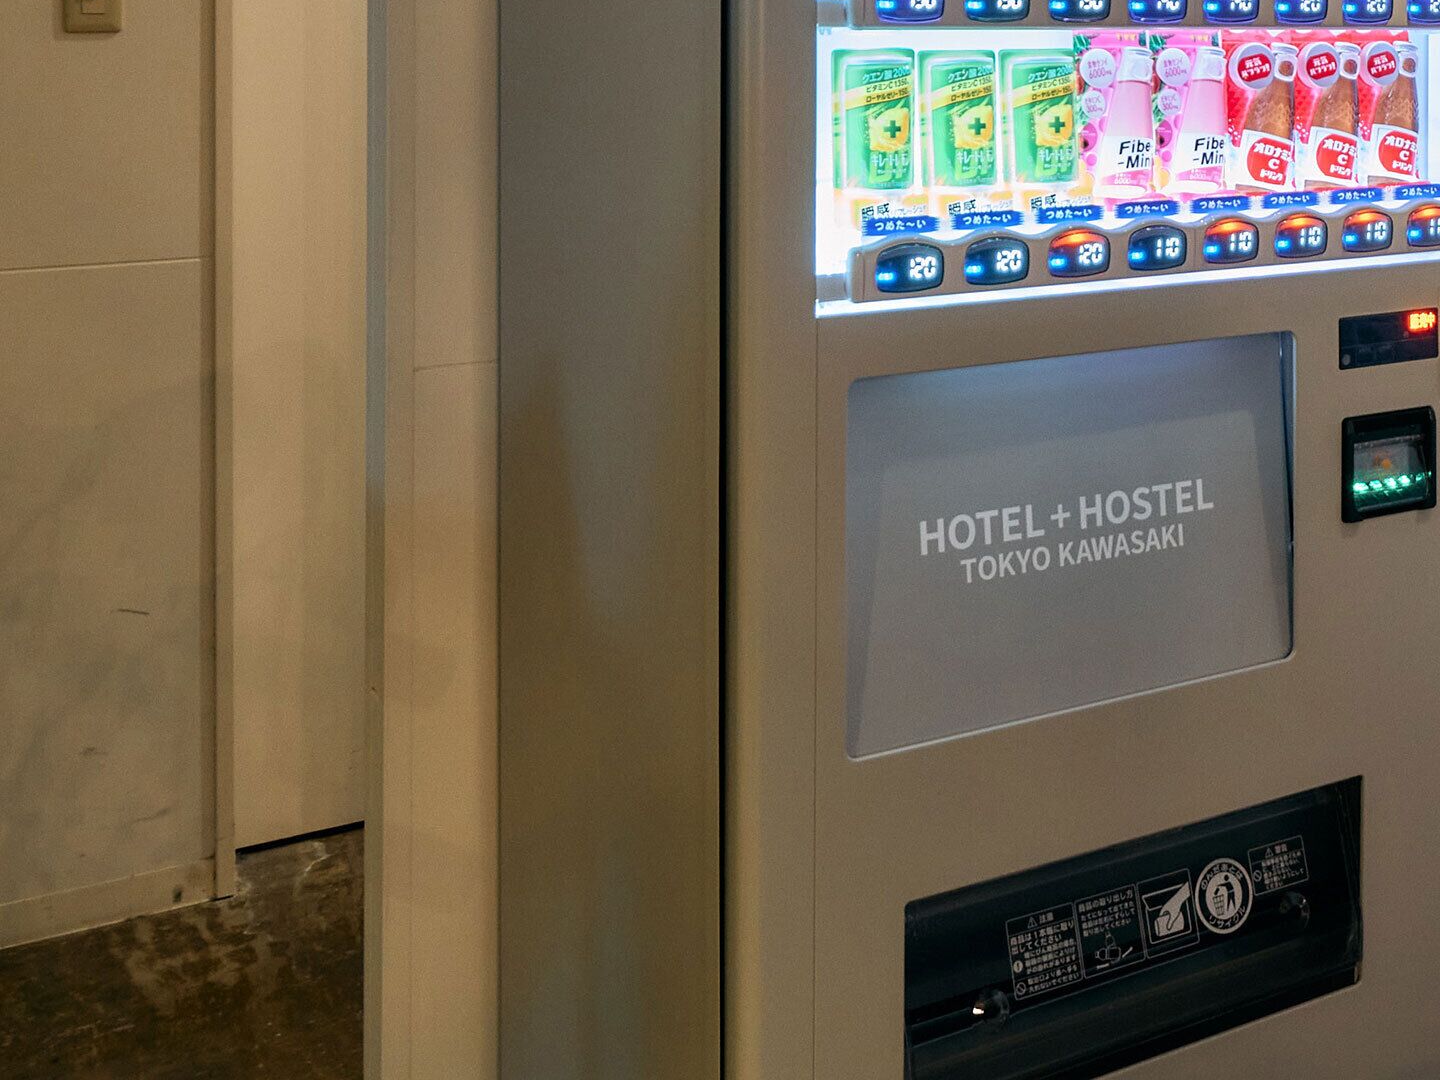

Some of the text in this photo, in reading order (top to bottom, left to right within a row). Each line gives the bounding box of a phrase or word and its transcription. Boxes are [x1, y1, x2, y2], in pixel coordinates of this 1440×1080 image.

[1119, 139, 1151, 155] Fibe
[1194, 137, 1225, 151] Fibe
[1268, 158, 1280, 169] C
[1337, 154, 1348, 164] C
[1399, 151, 1409, 160] C
[1229, 231, 1252, 251] 110
[1299, 226, 1321, 246] 110
[1366, 221, 1387, 241] 110
[1079, 243, 1103, 264] 120
[1155, 237, 1180, 258] 110
[910, 256, 937, 279] 120
[997, 249, 1023, 271] 120
[919, 504, 1045, 556] HOTEL
[1079, 478, 1214, 530] HOSTEL
[960, 523, 1185, 583] TOKYO KAWASAKI
